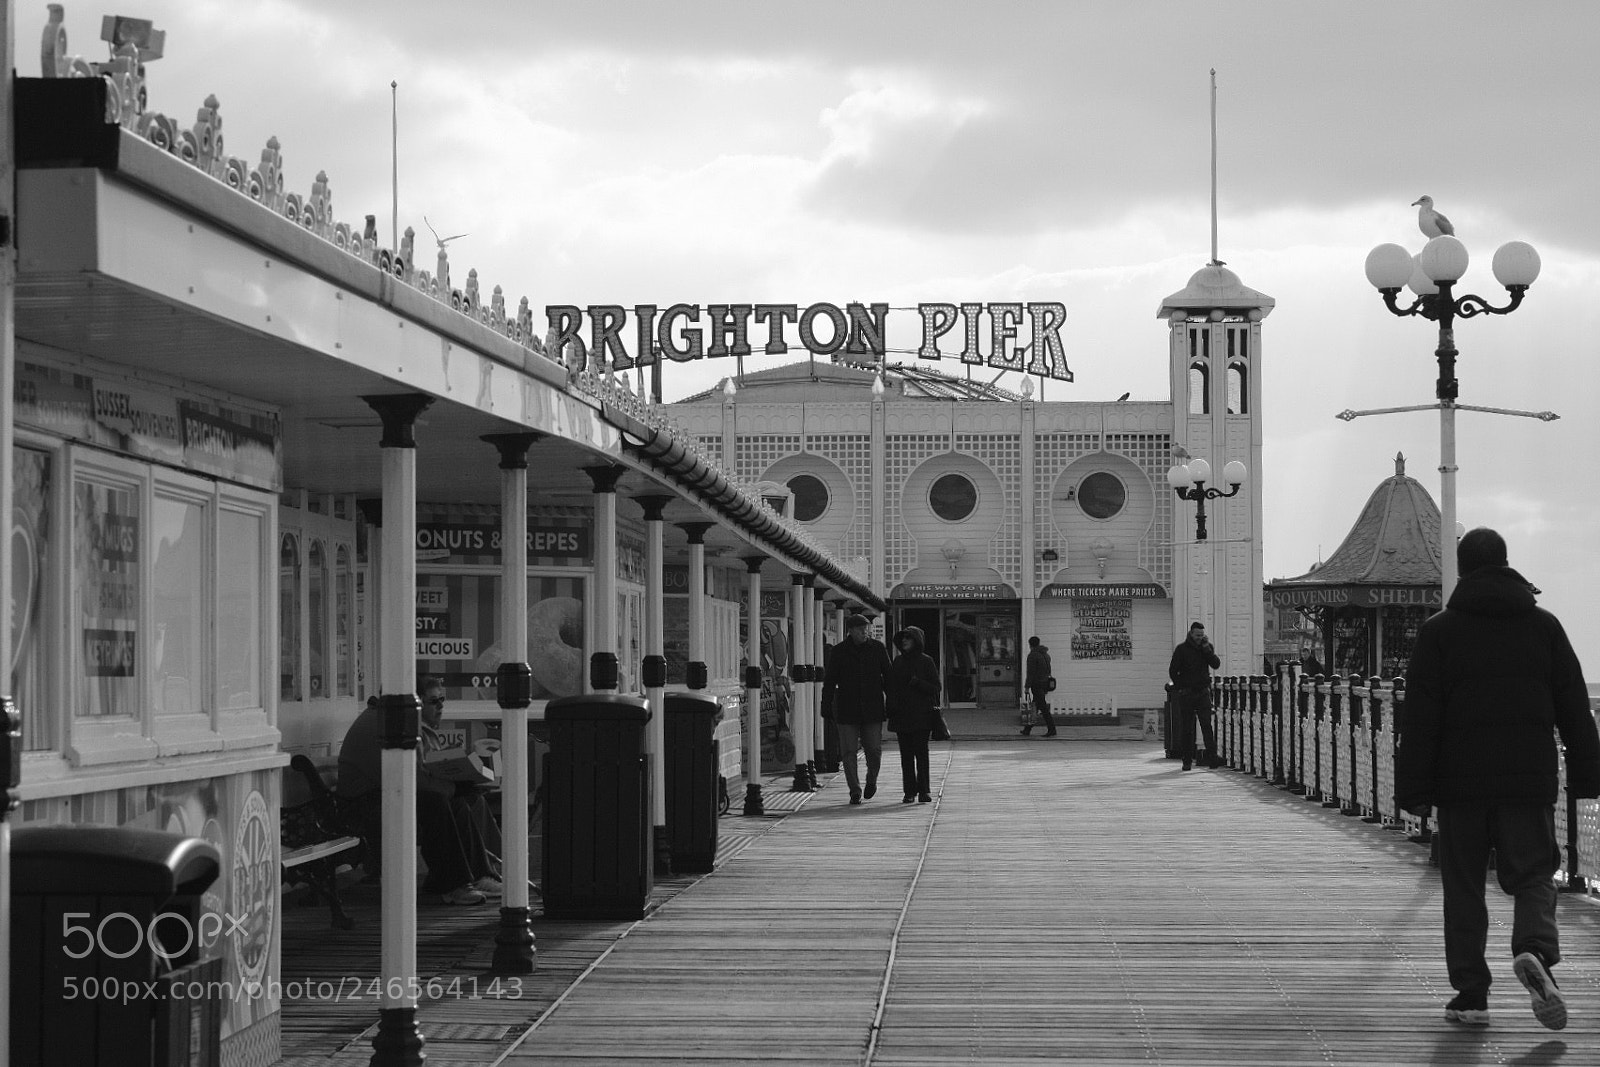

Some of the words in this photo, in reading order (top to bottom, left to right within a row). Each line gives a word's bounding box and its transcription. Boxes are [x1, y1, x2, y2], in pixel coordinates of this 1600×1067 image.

[546, 302, 889, 375] BRIGHTON
[918, 302, 1074, 382] PIER
[96, 388, 131, 420] SUSSEX
[186, 417, 234, 459] BRIGHTON
[104, 526, 134, 553] MUGS
[416, 529, 484, 549] ONUTS
[490, 530, 502, 549] &
[527, 532, 579, 551] REPES
[1052, 588, 1076, 597] WHERE
[1078, 588, 1106, 597] TICKETS
[1109, 588, 1129, 597] MAKE
[1132, 588, 1156, 597] PRIZES
[1274, 588, 1349, 606] SOUVENIRS
[1368, 588, 1442, 605] SHELLS
[416, 617, 438, 630] STY
[1080, 618, 1124, 627] MACHINES
[416, 641, 470, 655] LICIOUS
